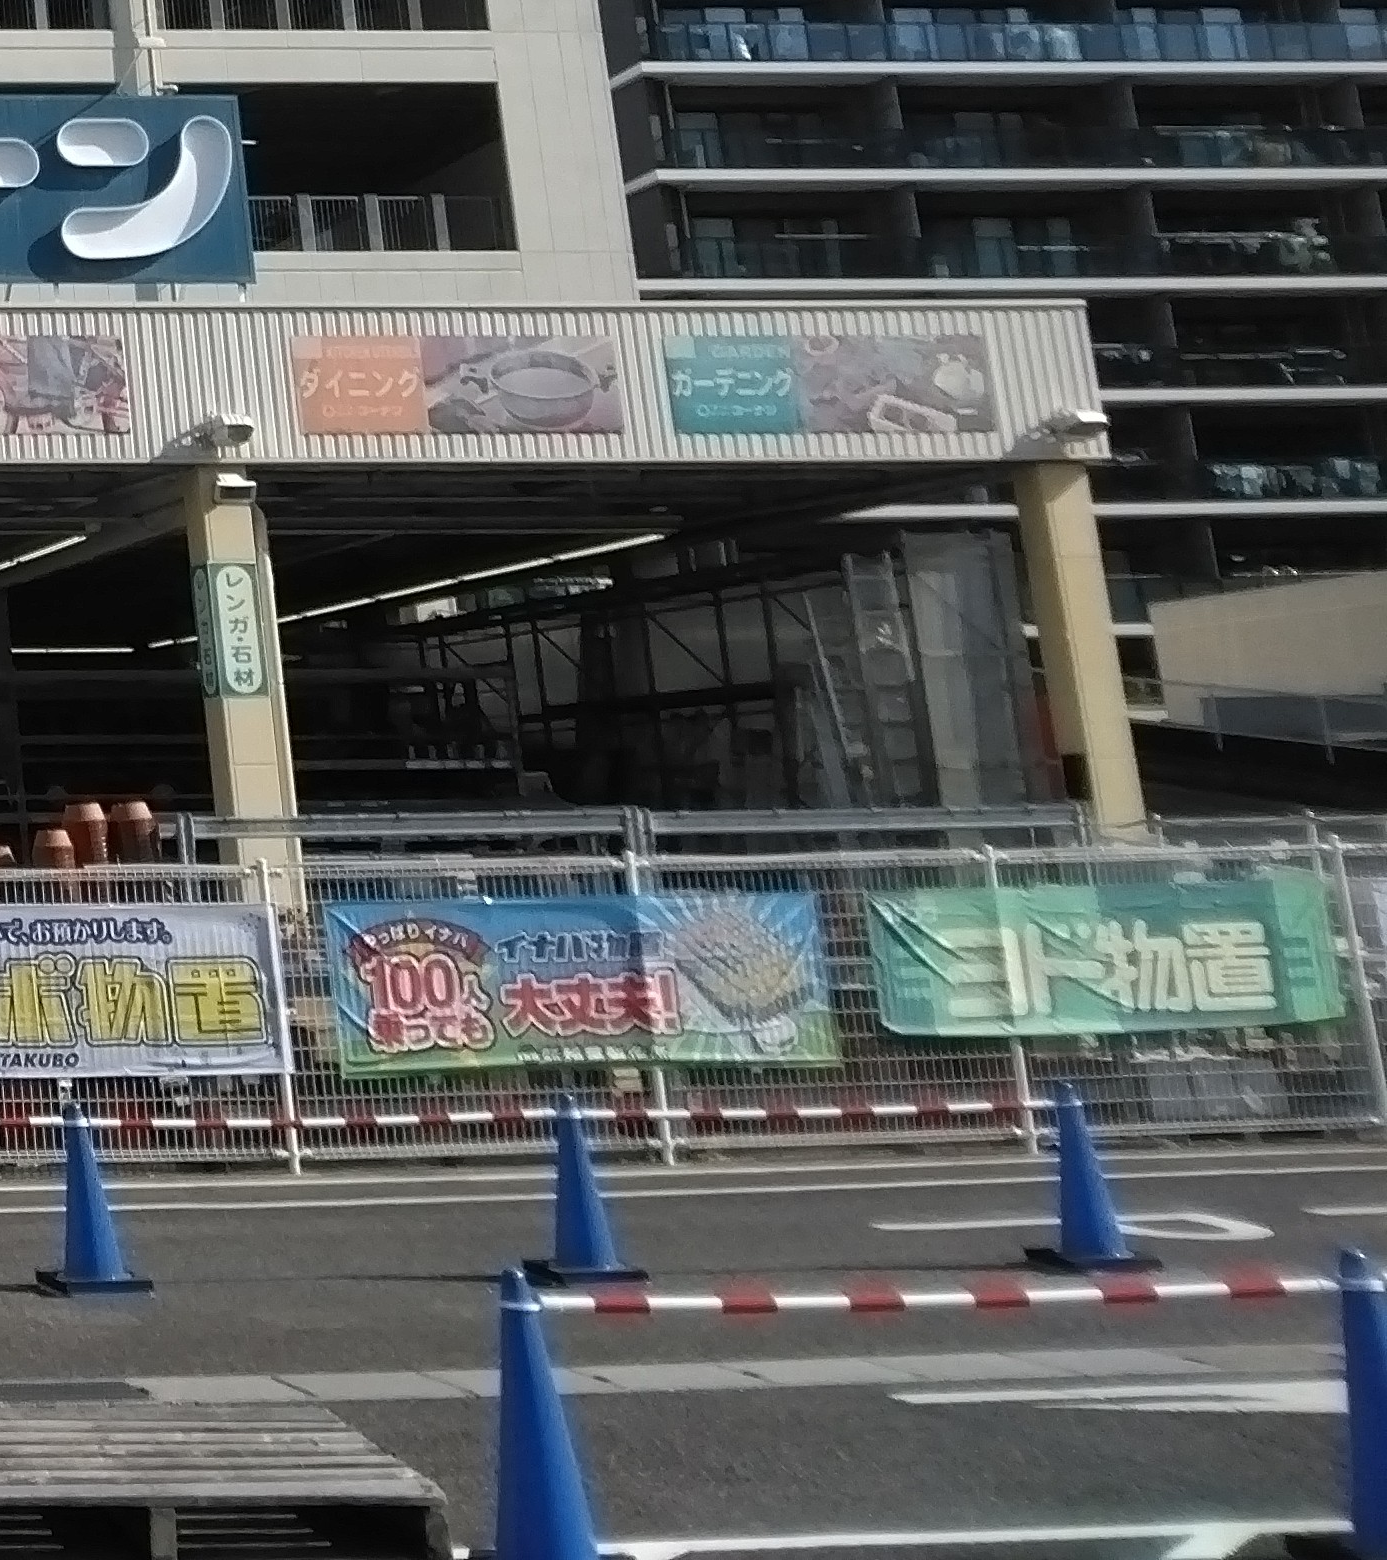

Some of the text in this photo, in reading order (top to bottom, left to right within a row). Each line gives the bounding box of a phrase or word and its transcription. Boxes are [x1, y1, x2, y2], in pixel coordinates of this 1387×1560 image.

[300, 367, 419, 398] ダイニング
[672, 367, 794, 397] ガーデニング
[225, 572, 256, 687] レンガ・石材
[944, 917, 1277, 1018] ヨド物置
[0, 1052, 80, 1069] TAKUBO
